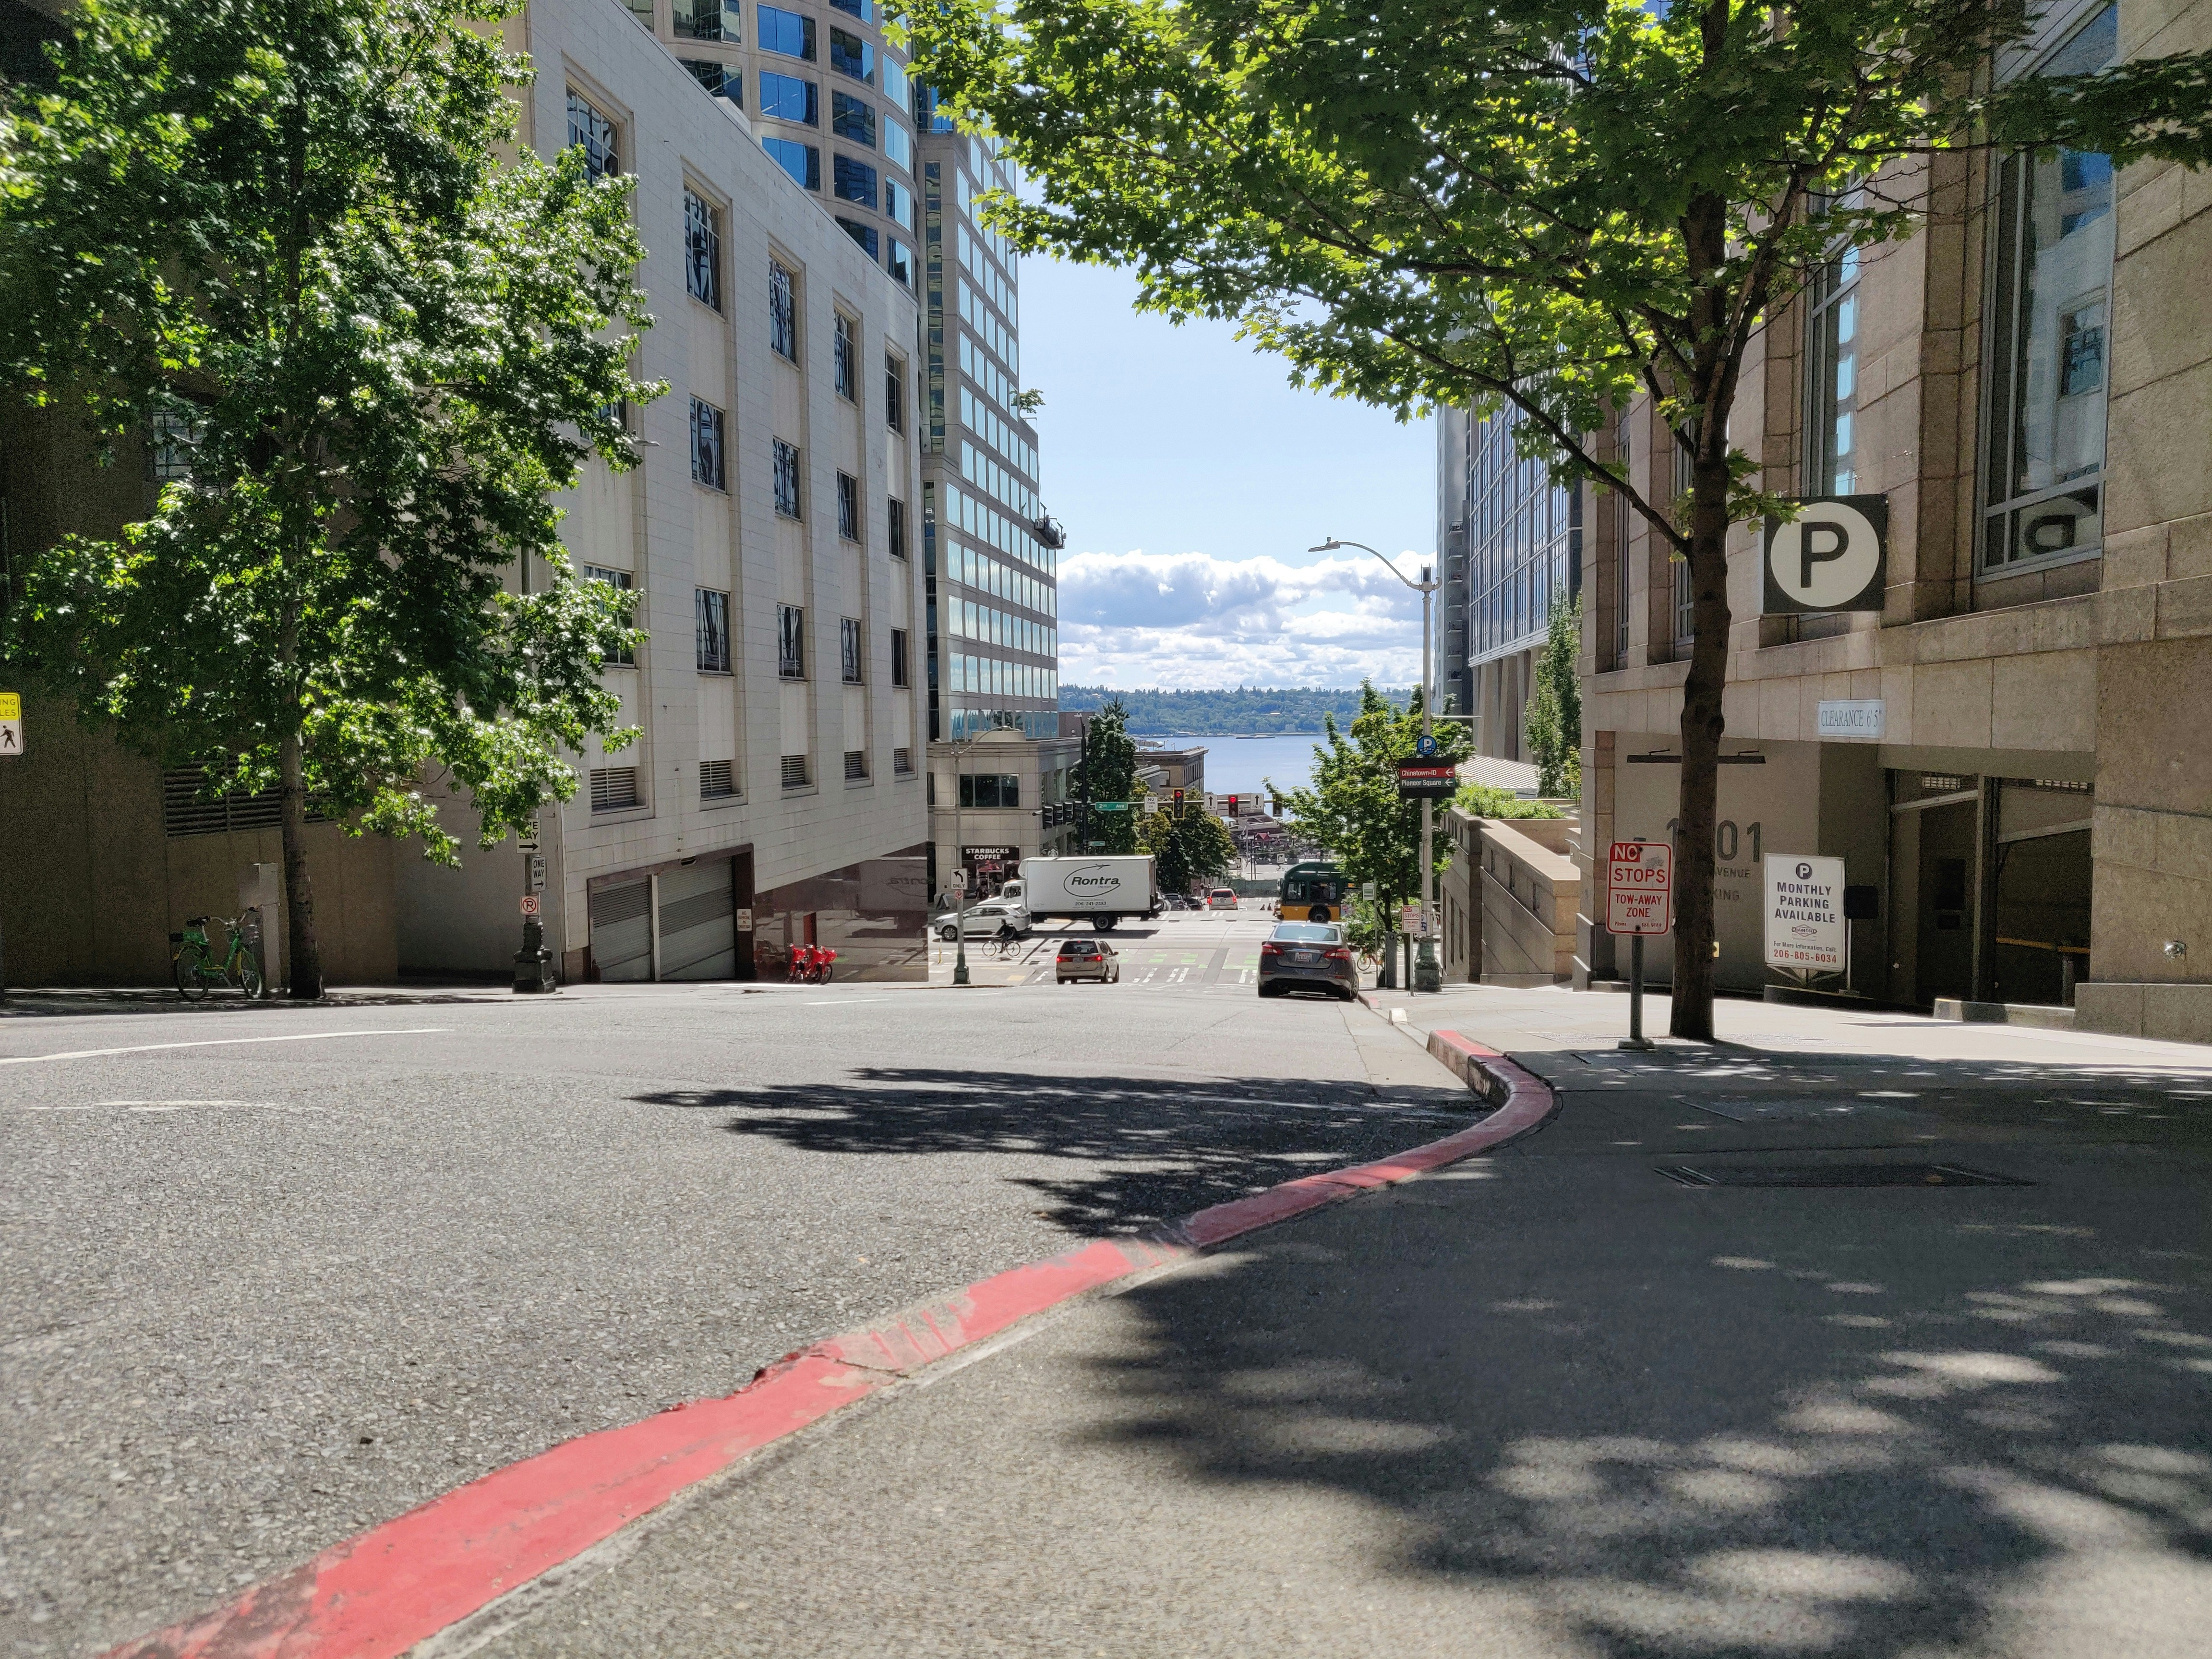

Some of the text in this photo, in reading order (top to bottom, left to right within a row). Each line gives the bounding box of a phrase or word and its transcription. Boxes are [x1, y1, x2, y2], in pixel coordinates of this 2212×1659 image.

[1801, 522, 1849, 588] P
[1821, 710, 1863, 726] CLEARANCE
[1423, 739, 1432, 748] P
[1667, 817, 1760, 863] 101
[1614, 845, 1638, 860] NO
[533, 859, 544, 868] ONE
[533, 869, 544, 878] WAY
[1614, 867, 1665, 883] STOPS
[1716, 867, 1751, 878] VENUE
[1799, 866, 1810, 878] P
[1071, 877, 1120, 885] Rontra
[1777, 881, 1831, 896] MONTHLY
[1615, 894, 1662, 905] TOW-AWAY
[1780, 895, 1829, 909] PARKING
[1626, 907, 1651, 917] ZONE
[1775, 908, 1835, 923] AVAILABLE
[1774, 949, 1837, 963] 206-805-6034
